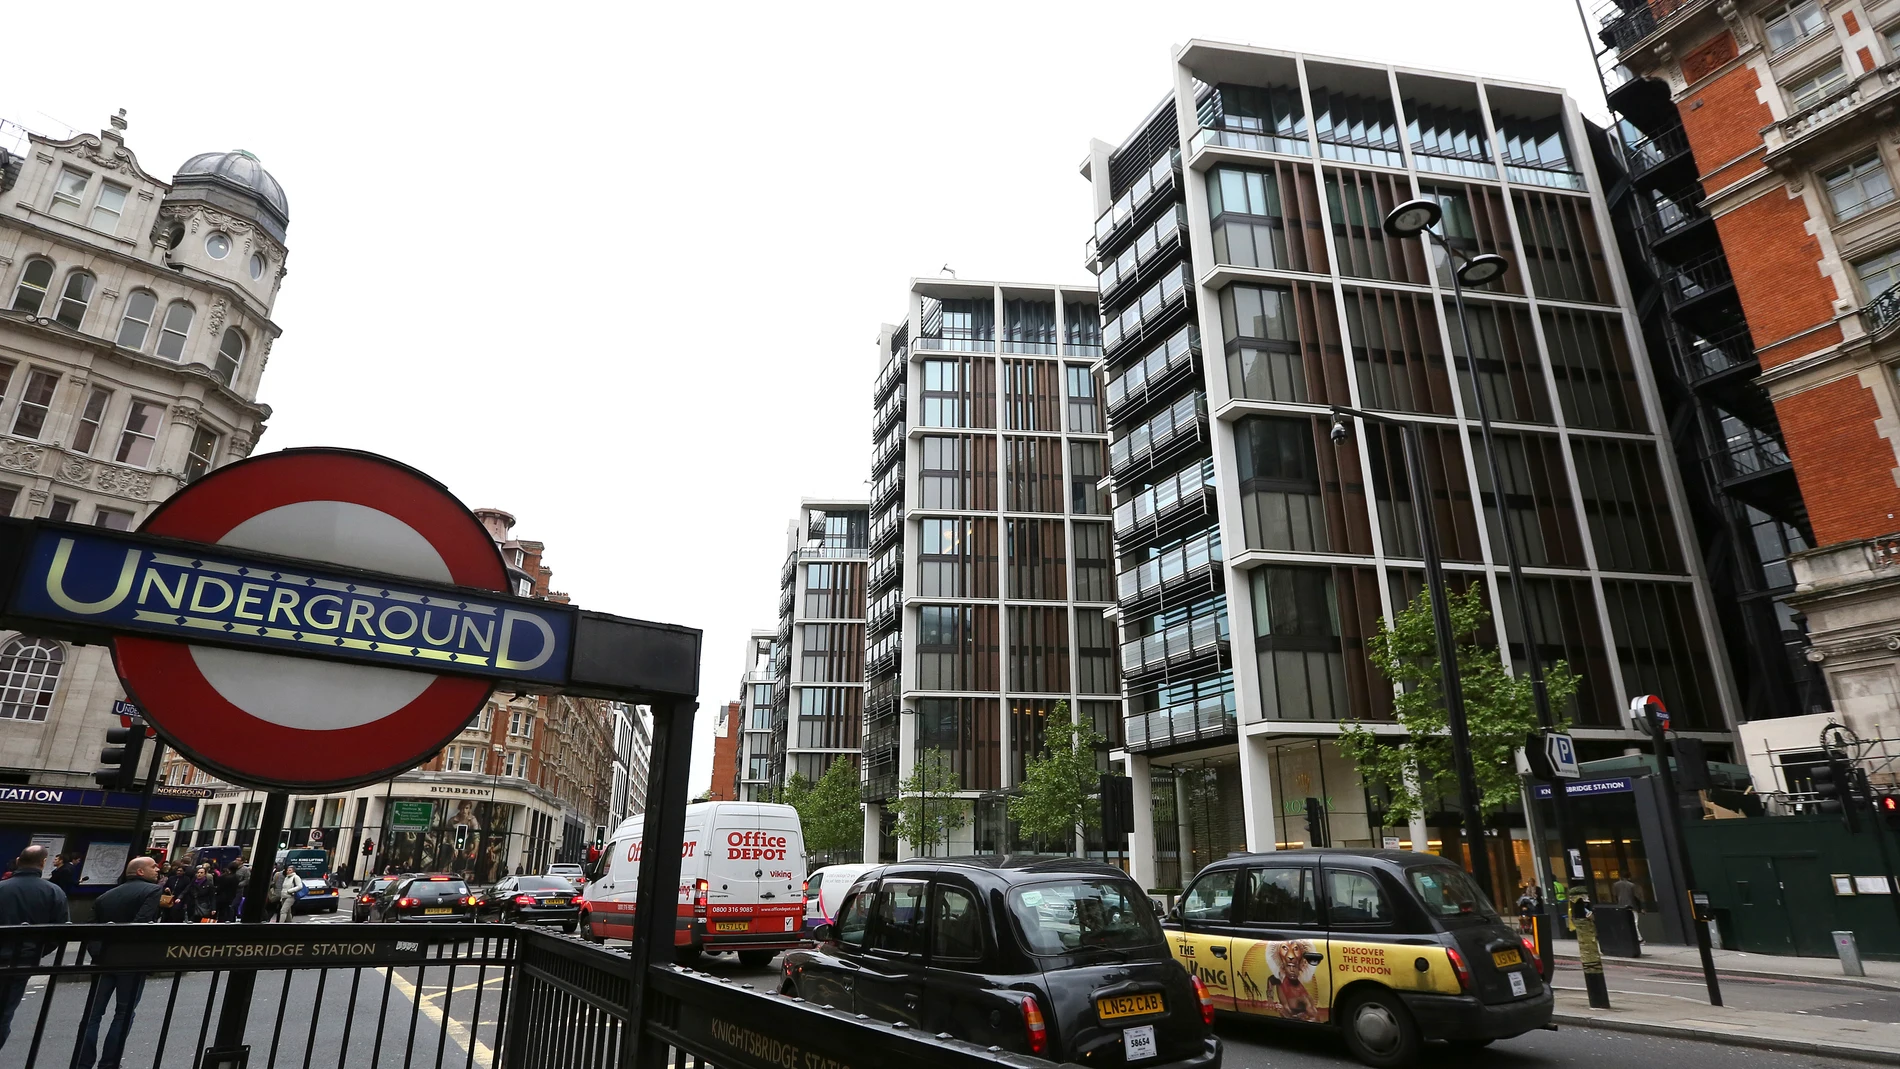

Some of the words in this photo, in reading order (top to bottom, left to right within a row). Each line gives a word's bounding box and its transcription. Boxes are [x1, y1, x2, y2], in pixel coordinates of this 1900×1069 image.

[46, 538, 556, 671] UNDERGROUND
[1560, 740, 1569, 761] P
[430, 786, 491, 796] BURBERRY
[1593, 781, 1625, 790] STATION
[0, 788, 63, 802] TATION
[157, 787, 212, 798] NDERGROUND
[727, 831, 787, 848] Office
[727, 848, 787, 861] DEPOT
[769, 869, 792, 881] Viking
[166, 944, 305, 959] KNIGHTSBRIDGE
[311, 942, 376, 956] STATION
[1179, 945, 1195, 956] THE
[1342, 946, 1385, 957] DISCOVER
[1343, 955, 1359, 964] THE
[1360, 956, 1386, 966] PRIDE
[1338, 963, 1350, 972] OF
[1352, 965, 1392, 976] LONDON
[1102, 998, 1135, 1015] LN52
[1136, 995, 1159, 1011] CAB
[711, 1017, 800, 1069] KNIGHTSBRIDGE
[1130, 1037, 1151, 1048] 58654
